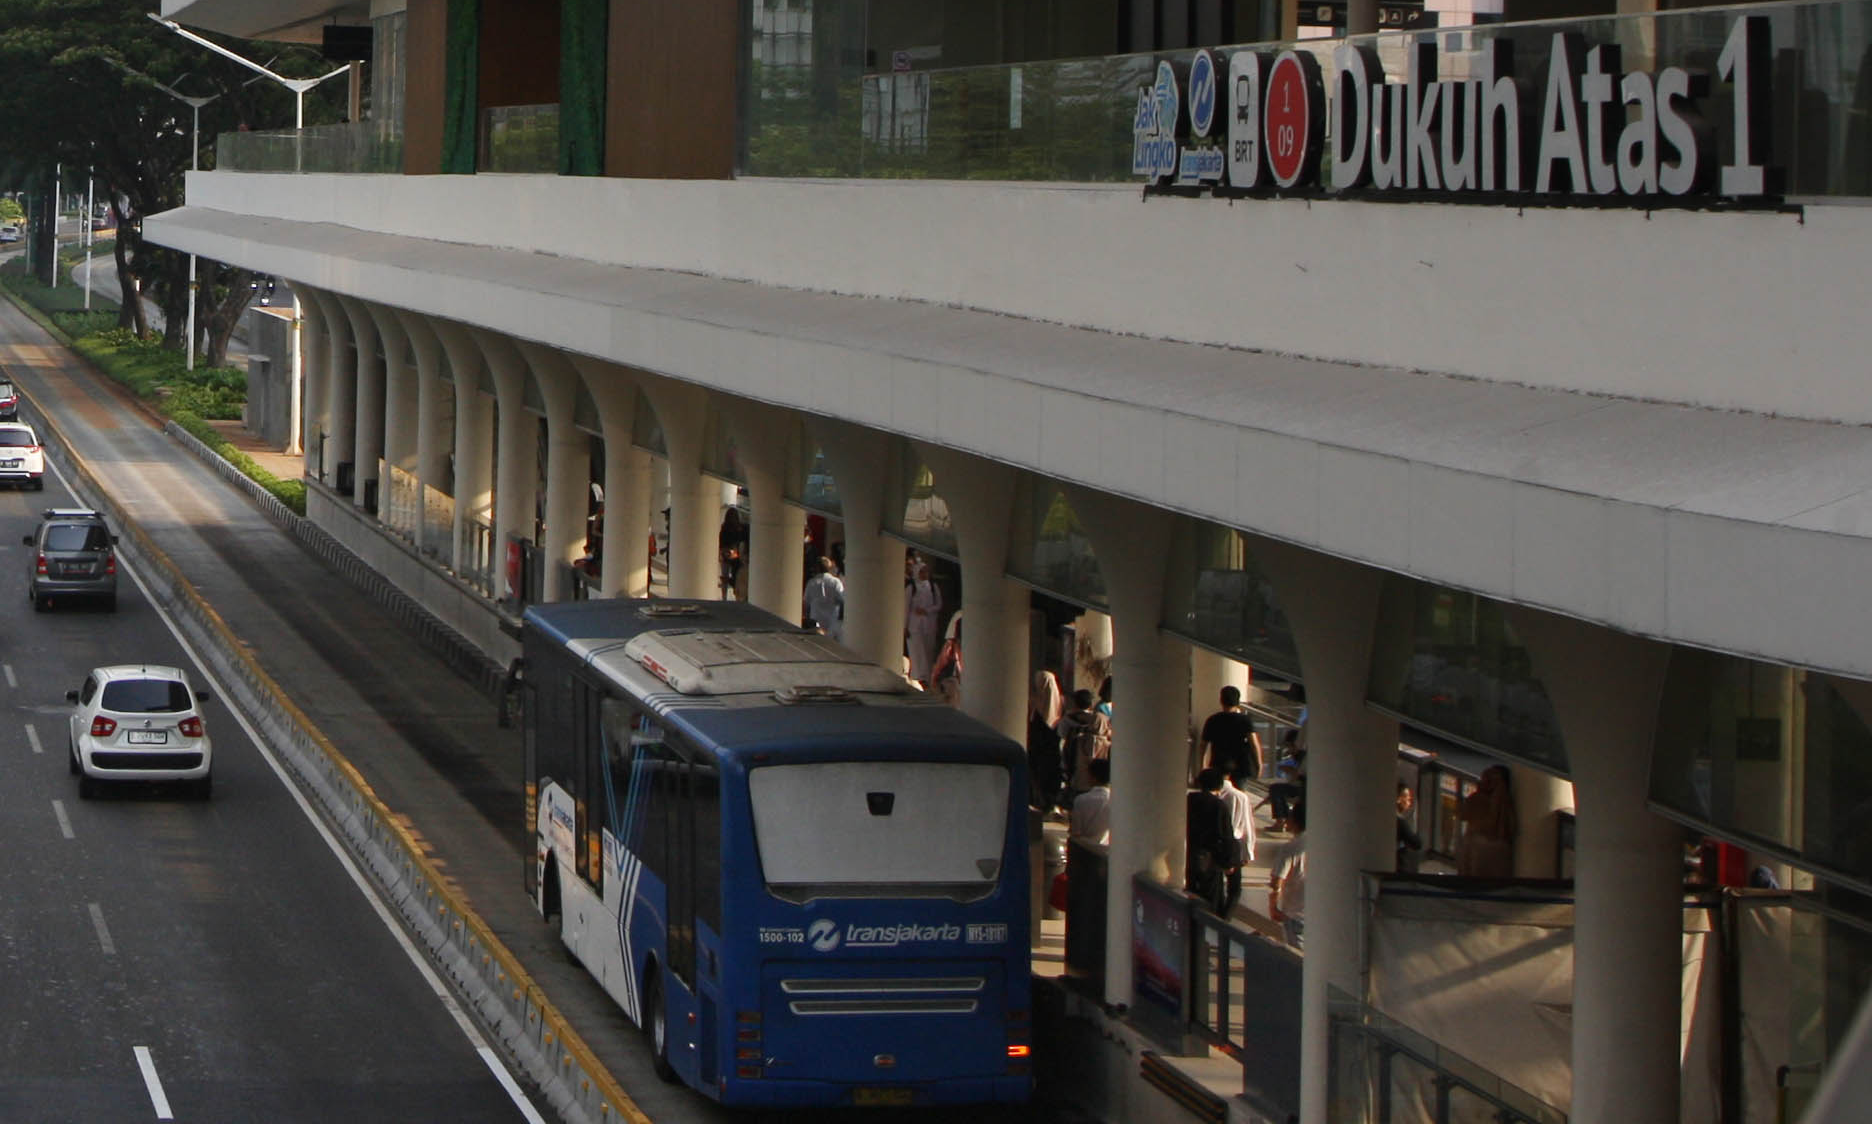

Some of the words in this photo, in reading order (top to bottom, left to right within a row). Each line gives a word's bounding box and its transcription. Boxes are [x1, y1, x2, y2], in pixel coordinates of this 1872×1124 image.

[1135, 88, 1156, 130] Jak
[1282, 80, 1291, 113] 1
[1331, 37, 1520, 191] Dukuh
[1535, 32, 1698, 196] Atas
[1716, 15, 1764, 196] 1
[1134, 133, 1175, 178] Lingko
[1235, 140, 1254, 164] BRT
[1278, 124, 1294, 157] 09
[759, 932, 805, 943] 1500-102
[845, 923, 961, 947] transjakarta
